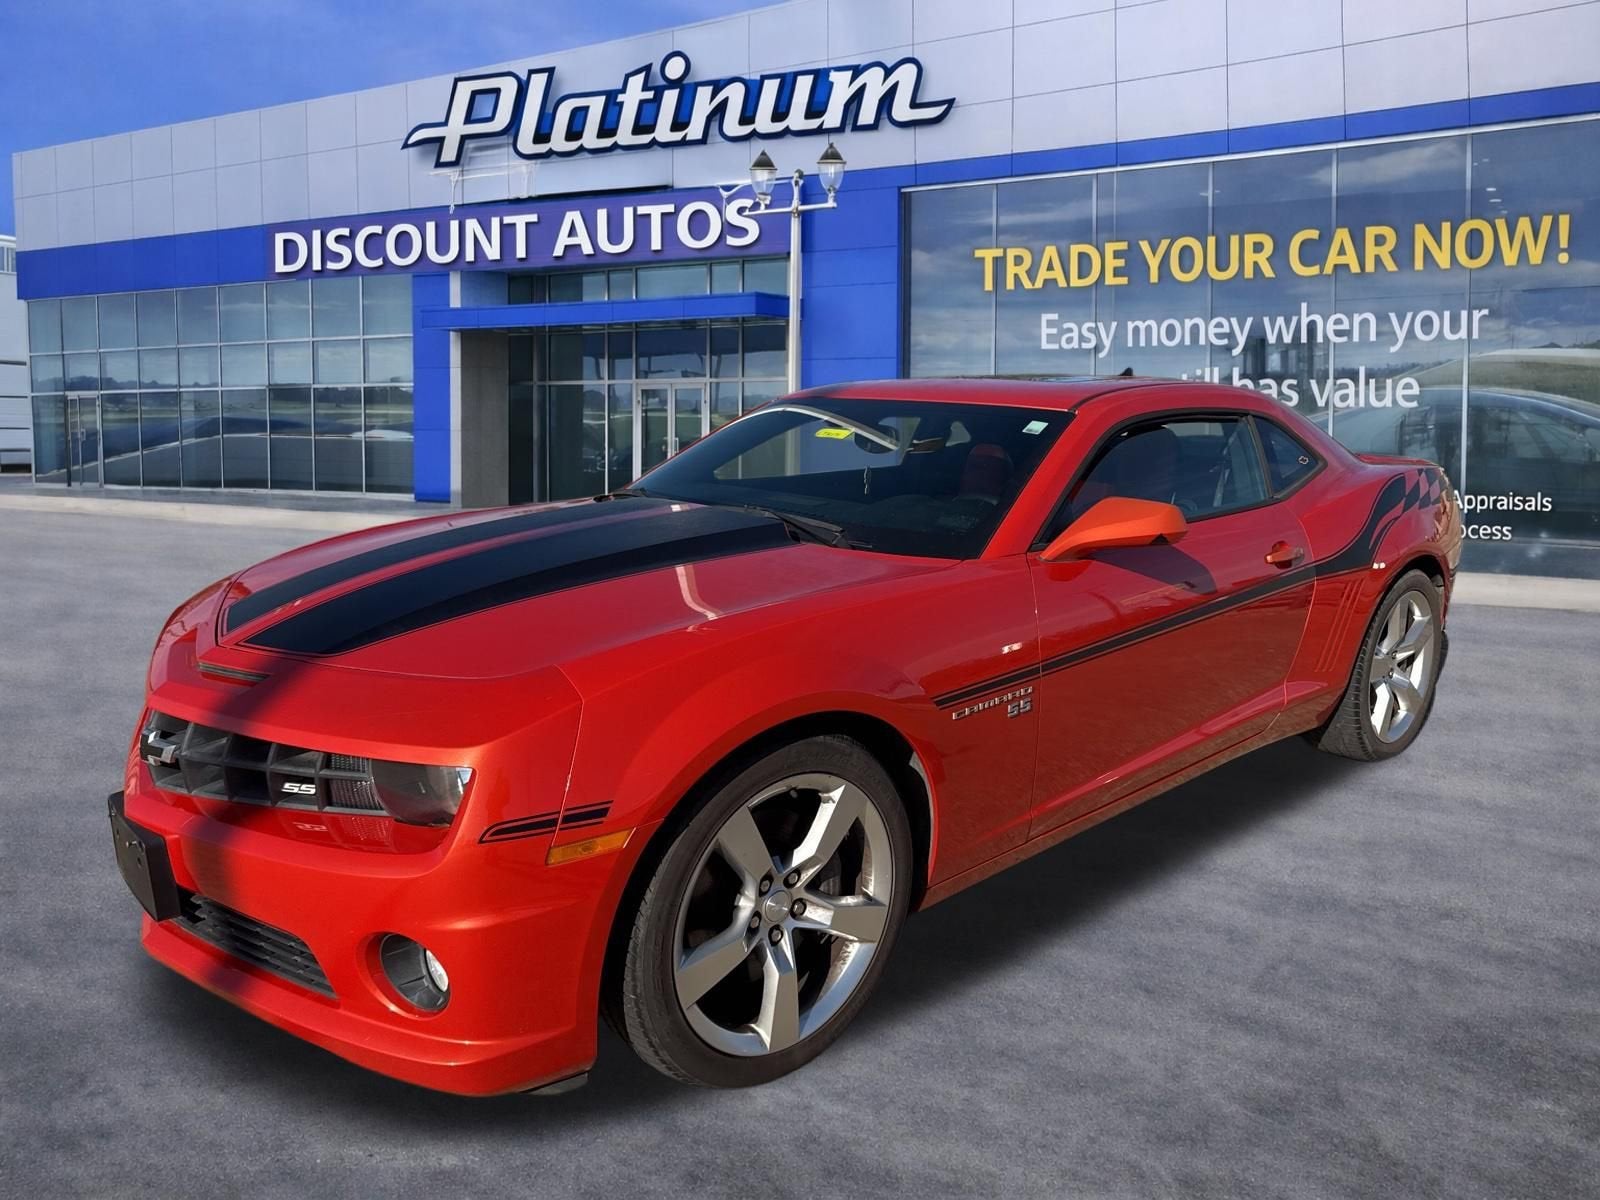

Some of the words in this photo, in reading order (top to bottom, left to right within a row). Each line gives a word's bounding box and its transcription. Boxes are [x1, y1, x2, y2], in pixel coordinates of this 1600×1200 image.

[401, 50, 955, 168] Platinum
[273, 213, 540, 275] DISCOUNT
[552, 197, 761, 258] AUTOS
[974, 240, 1129, 292] TRADE
[1138, 232, 1276, 284] YOUR
[1288, 226, 1398, 277] CAR
[1414, 213, 1571, 270] NOW!
[1040, 312, 1118, 358] Easy
[1127, 315, 1254, 356] money
[1263, 302, 1378, 345] when
[1388, 307, 1489, 353] your
[1309, 366, 1420, 408] value
[1007, 698, 1032, 718] SS
[281, 782, 316, 795] SS
